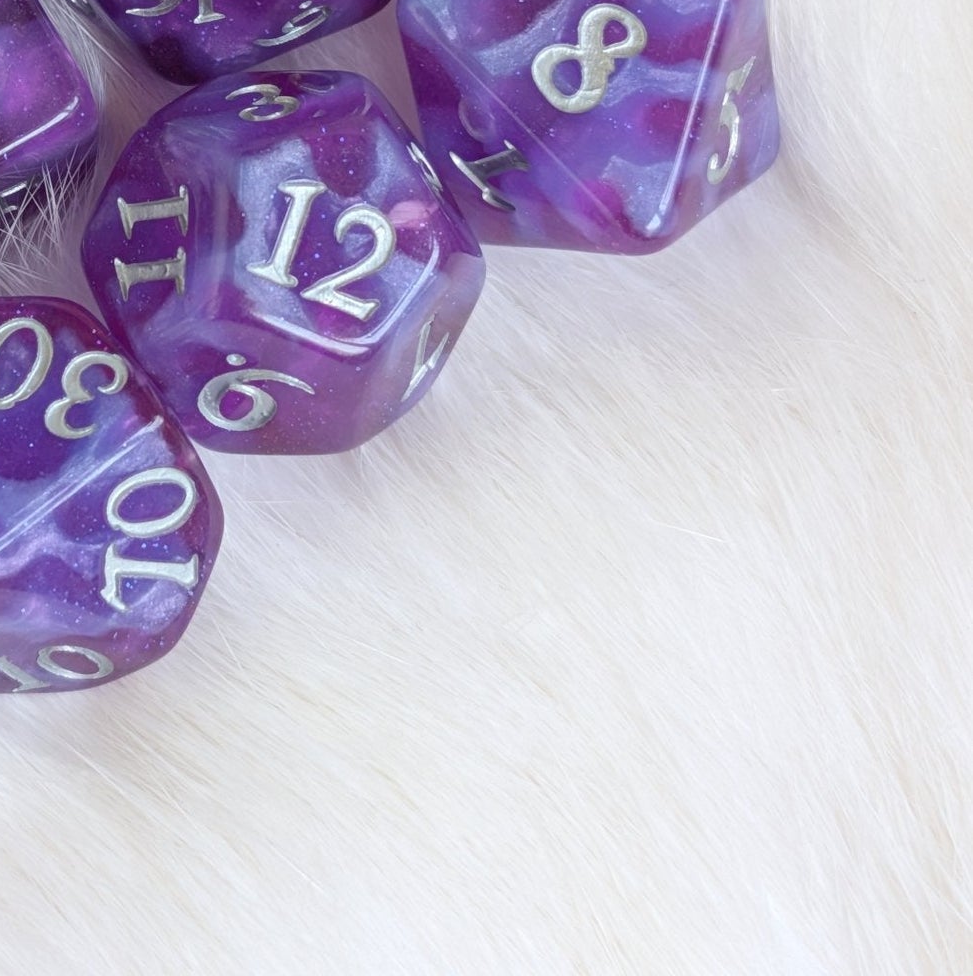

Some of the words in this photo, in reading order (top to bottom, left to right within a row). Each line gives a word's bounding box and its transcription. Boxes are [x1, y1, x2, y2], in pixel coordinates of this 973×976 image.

[226, 83, 300, 122] 3
[531, 3, 647, 114] 8
[707, 56, 756, 184] 5
[114, 184, 190, 301] 11
[246, 178, 397, 322] 12
